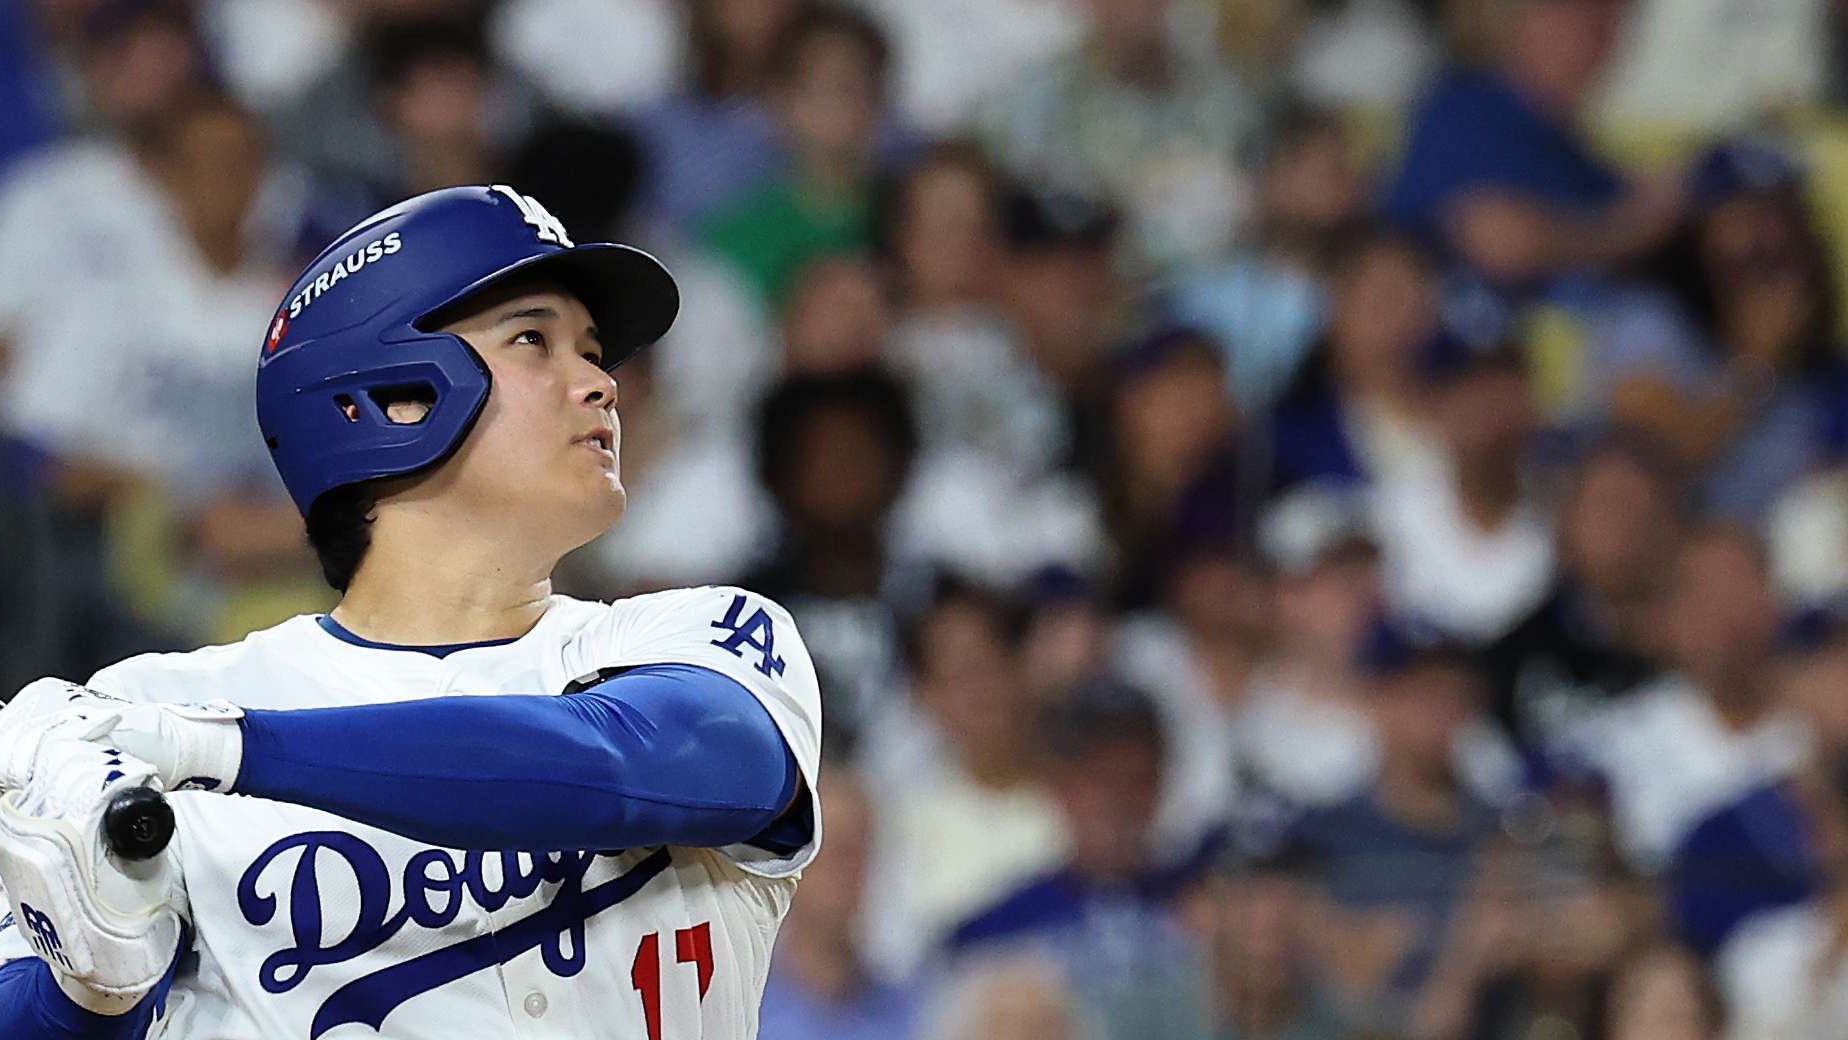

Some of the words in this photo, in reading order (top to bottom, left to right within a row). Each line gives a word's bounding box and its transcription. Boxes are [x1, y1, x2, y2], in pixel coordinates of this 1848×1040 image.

[491, 184, 575, 249] LA
[289, 232, 402, 319] STRAUSS
[710, 594, 787, 678] LA
[238, 831, 628, 993] Dodg
